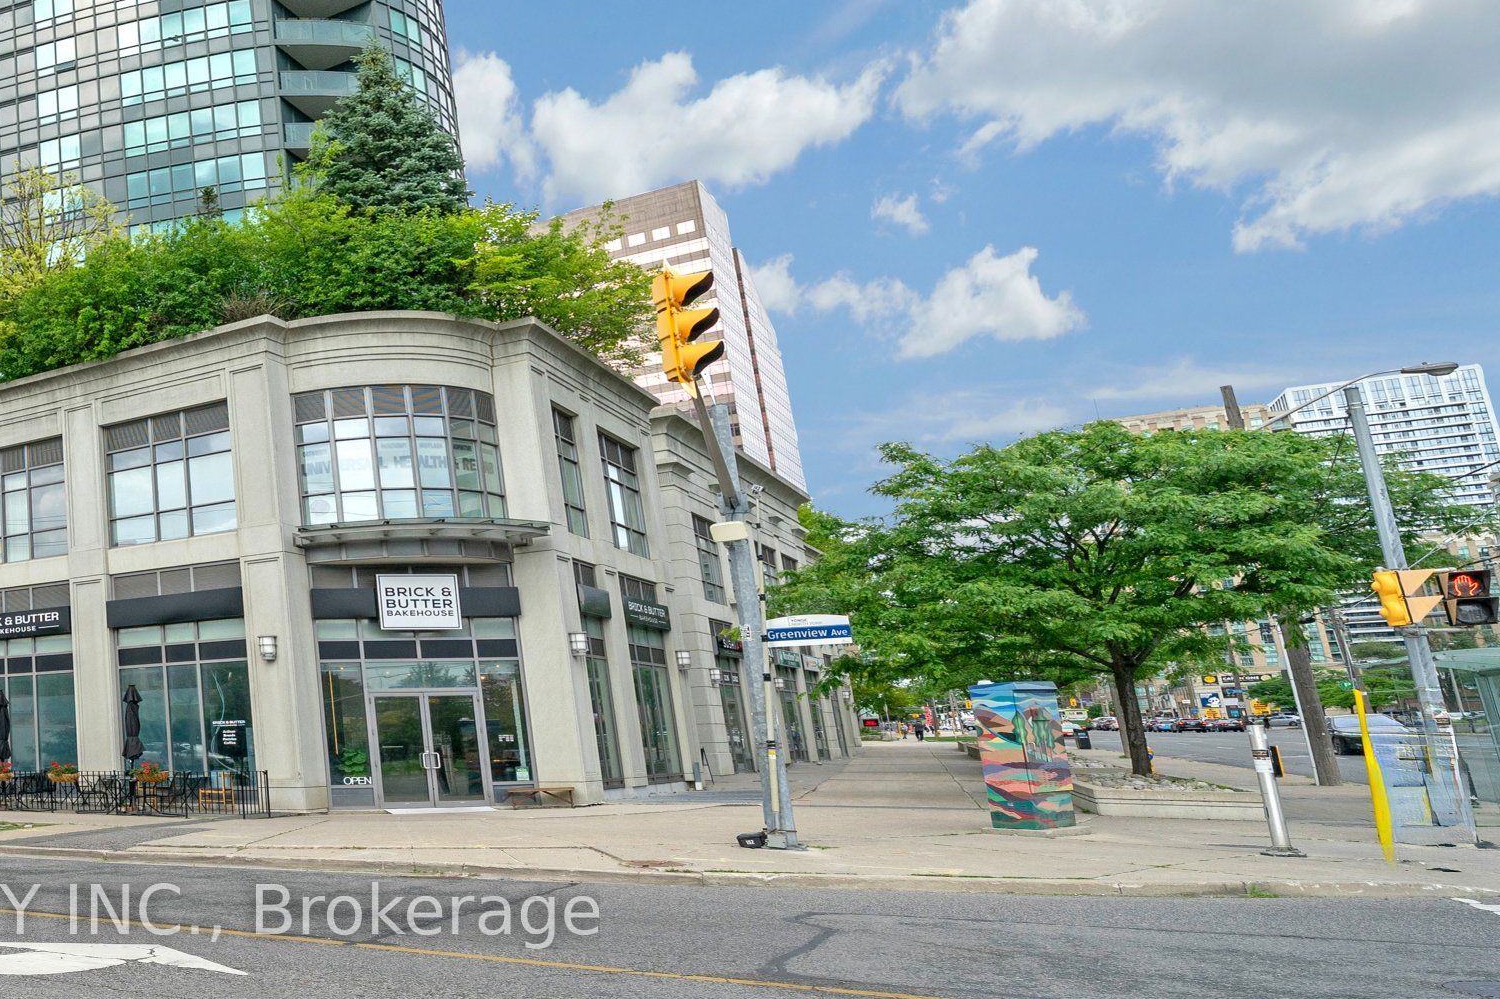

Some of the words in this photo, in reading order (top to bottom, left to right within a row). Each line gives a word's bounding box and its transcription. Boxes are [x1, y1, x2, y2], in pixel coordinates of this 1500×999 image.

[384, 587, 436, 597] BRICK
[441, 587, 452, 597] &
[386, 598, 453, 609] BUTTER
[386, 609, 454, 617] BAKEHOUSE
[4, 616, 13, 626] &
[15, 611, 60, 625] BUTTER
[767, 628, 828, 640] Greenview
[831, 628, 848, 636] Ave
[343, 776, 372, 785] OPEN
